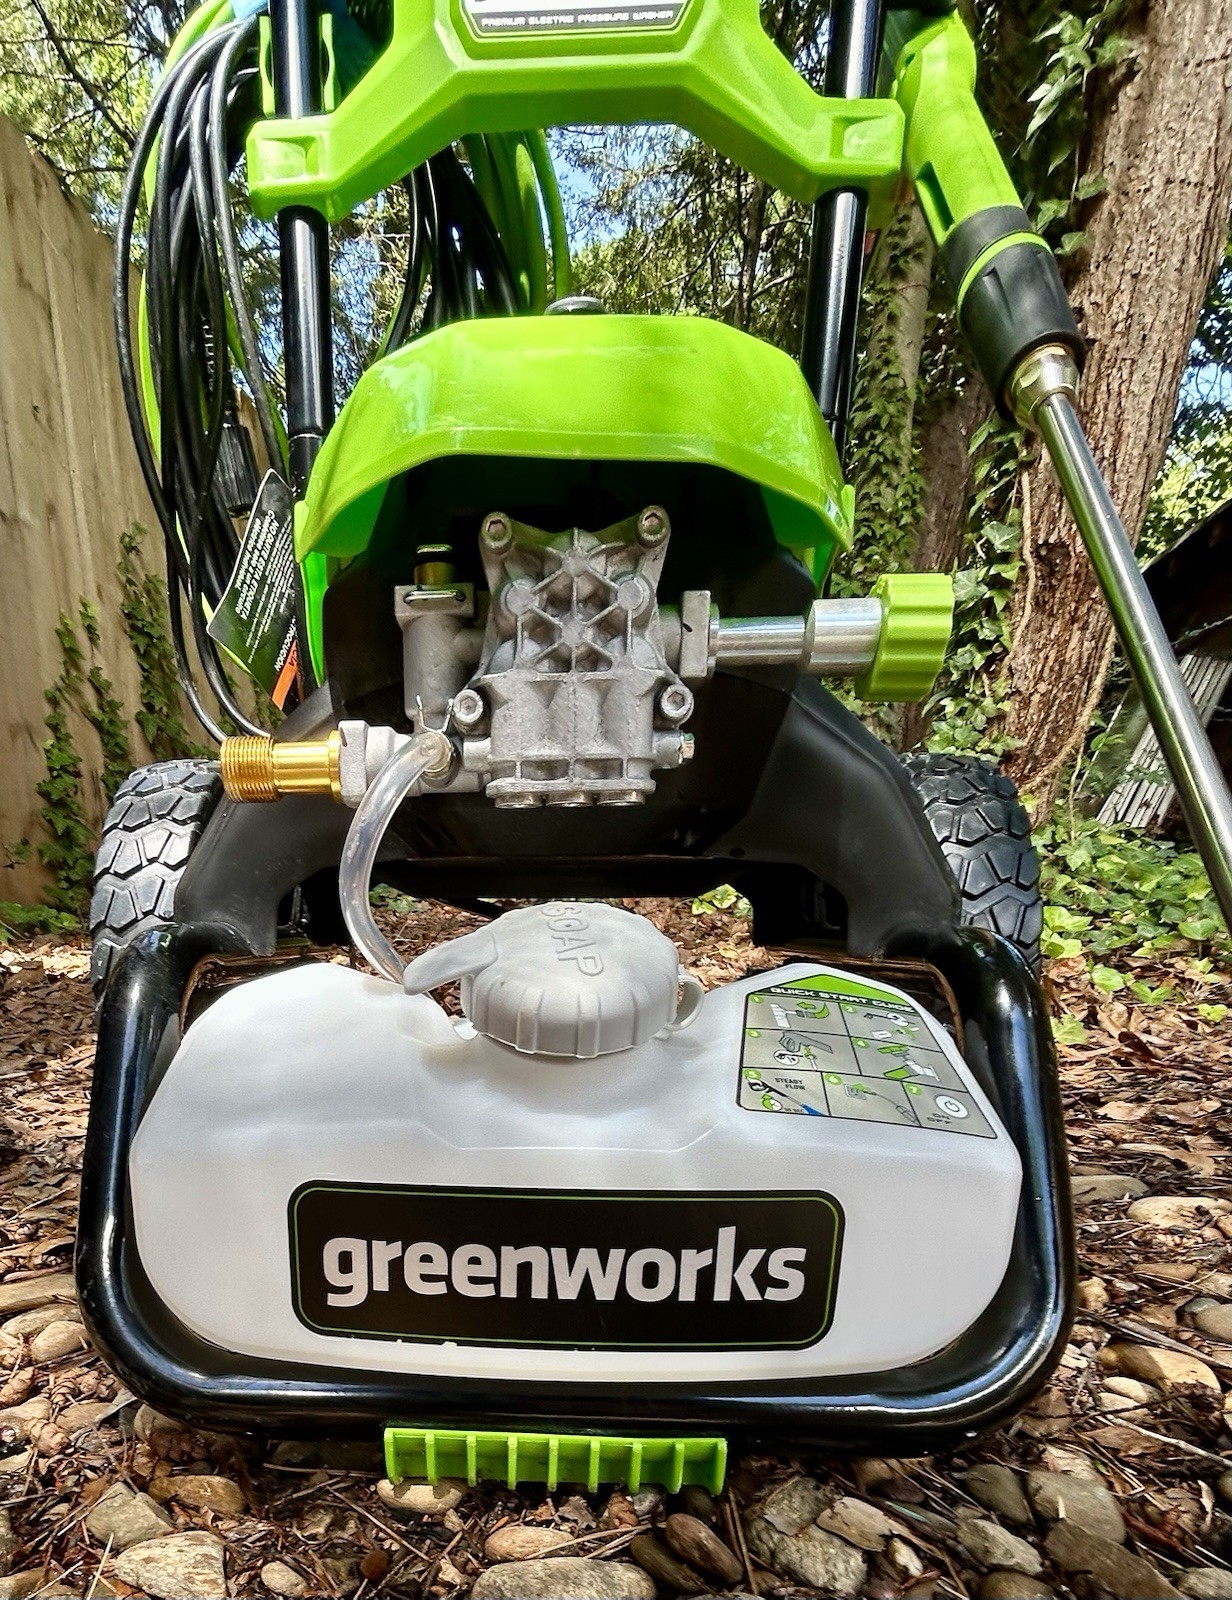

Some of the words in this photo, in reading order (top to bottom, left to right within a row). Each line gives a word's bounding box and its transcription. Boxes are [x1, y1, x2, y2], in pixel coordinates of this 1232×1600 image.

[482, 17, 525, 26] PREMIUM
[528, 15, 574, 25] ELECTRIC
[577, 13, 629, 23] PRESSURE
[633, 10, 673, 20] WASHER
[269, 519, 280, 535] NO
[260, 533, 275, 561] QUITE
[253, 557, 267, 580] ESTA
[240, 579, 259, 620] ETIQUETA
[540, 906, 604, 976] SOAP
[771, 987, 815, 996] QUICK
[819, 992, 868, 1003] START
[872, 1000, 915, 1013] GUIDE
[322, 1225, 807, 1308] greenworks
